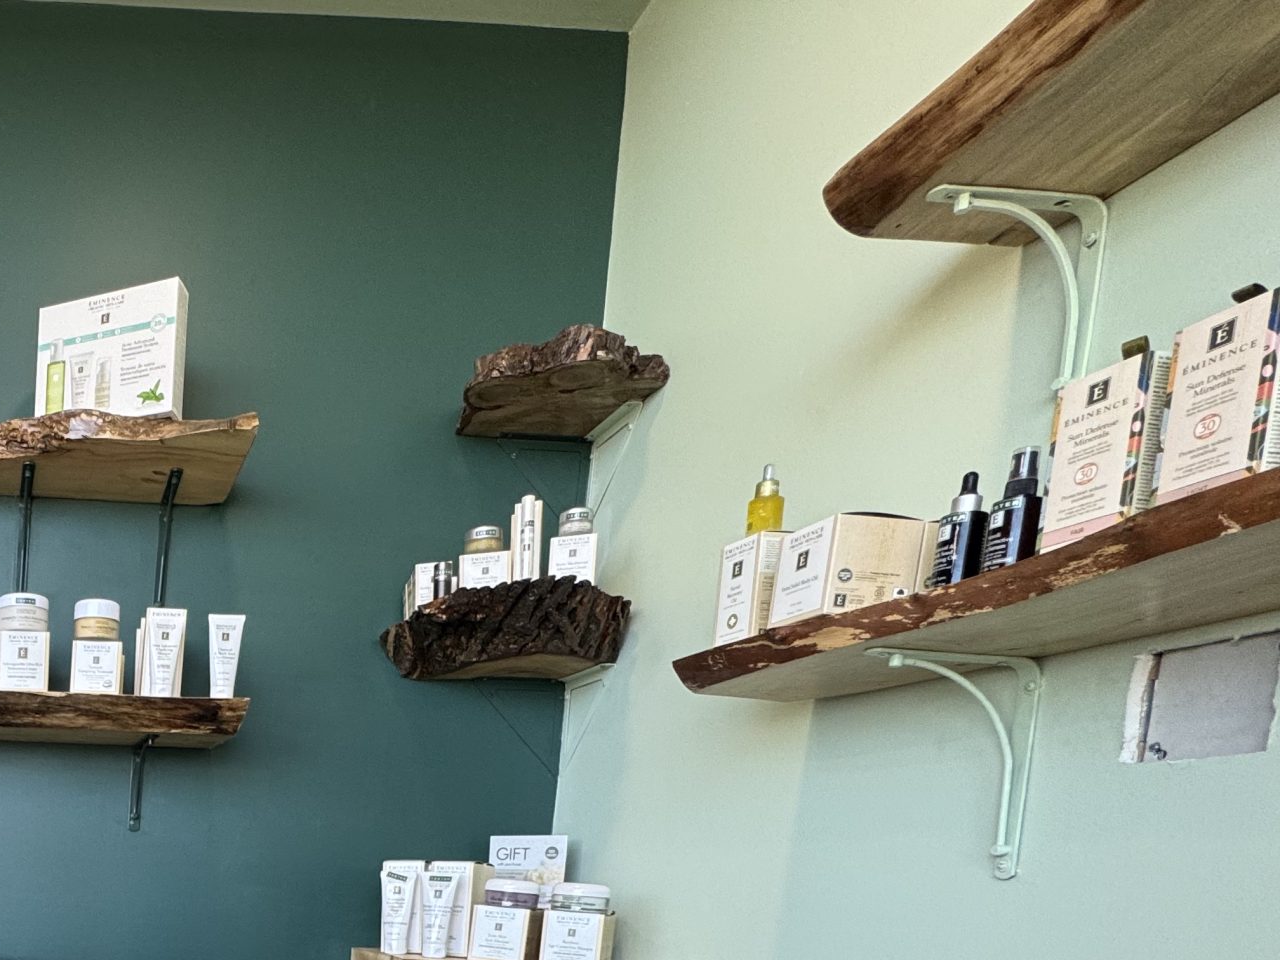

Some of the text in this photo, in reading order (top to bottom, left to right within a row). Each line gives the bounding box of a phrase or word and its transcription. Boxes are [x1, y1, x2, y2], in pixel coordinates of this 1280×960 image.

[1199, 419, 1216, 434] 30
[1079, 467, 1093, 480] 30
[496, 847, 530, 861] GIFT
